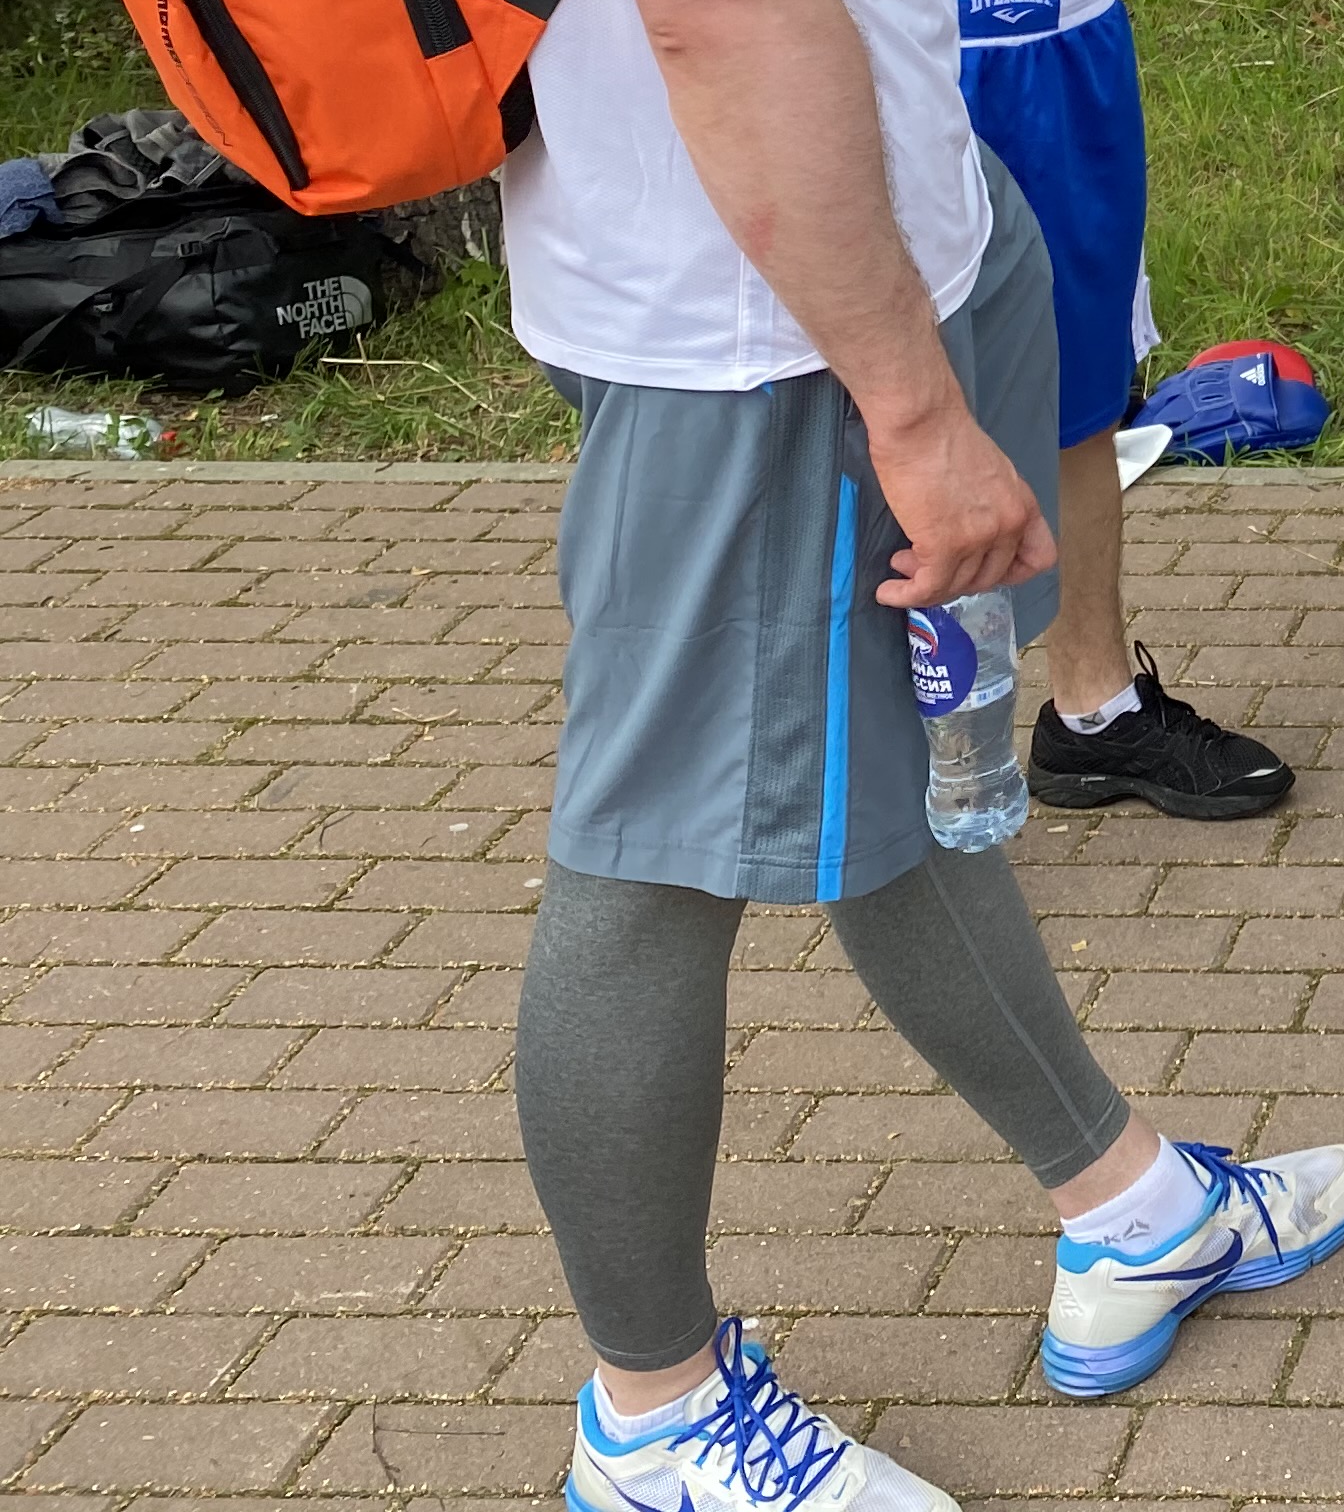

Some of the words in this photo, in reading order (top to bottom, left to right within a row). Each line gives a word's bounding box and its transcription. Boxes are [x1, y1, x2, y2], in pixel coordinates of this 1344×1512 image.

[302, 276, 342, 301] THE
[275, 294, 345, 326] NORTH
[298, 311, 347, 339] FACE
[911, 661, 949, 678] ИНАЯ
[912, 674, 953, 693] ССИЯ
